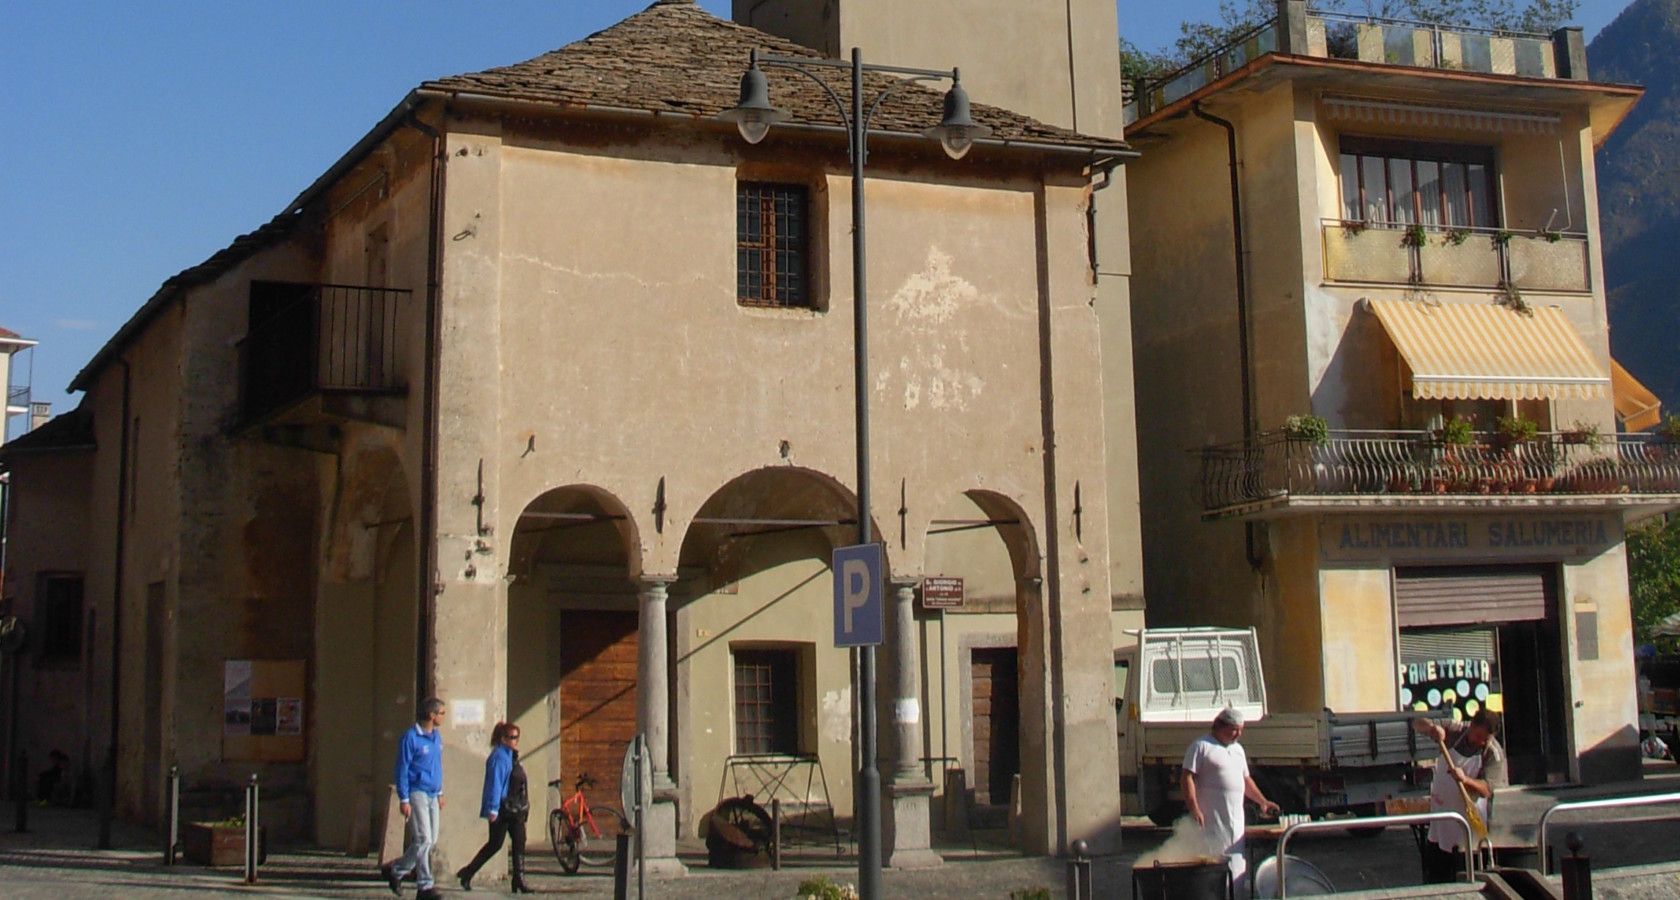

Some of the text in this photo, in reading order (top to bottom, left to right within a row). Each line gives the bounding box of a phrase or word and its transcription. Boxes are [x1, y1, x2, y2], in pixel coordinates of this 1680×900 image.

[1340, 520, 1608, 548] ALIMENTARI SALUMERIA
[843, 559, 870, 633] P
[1400, 657, 1490, 685] PANETTERIA
